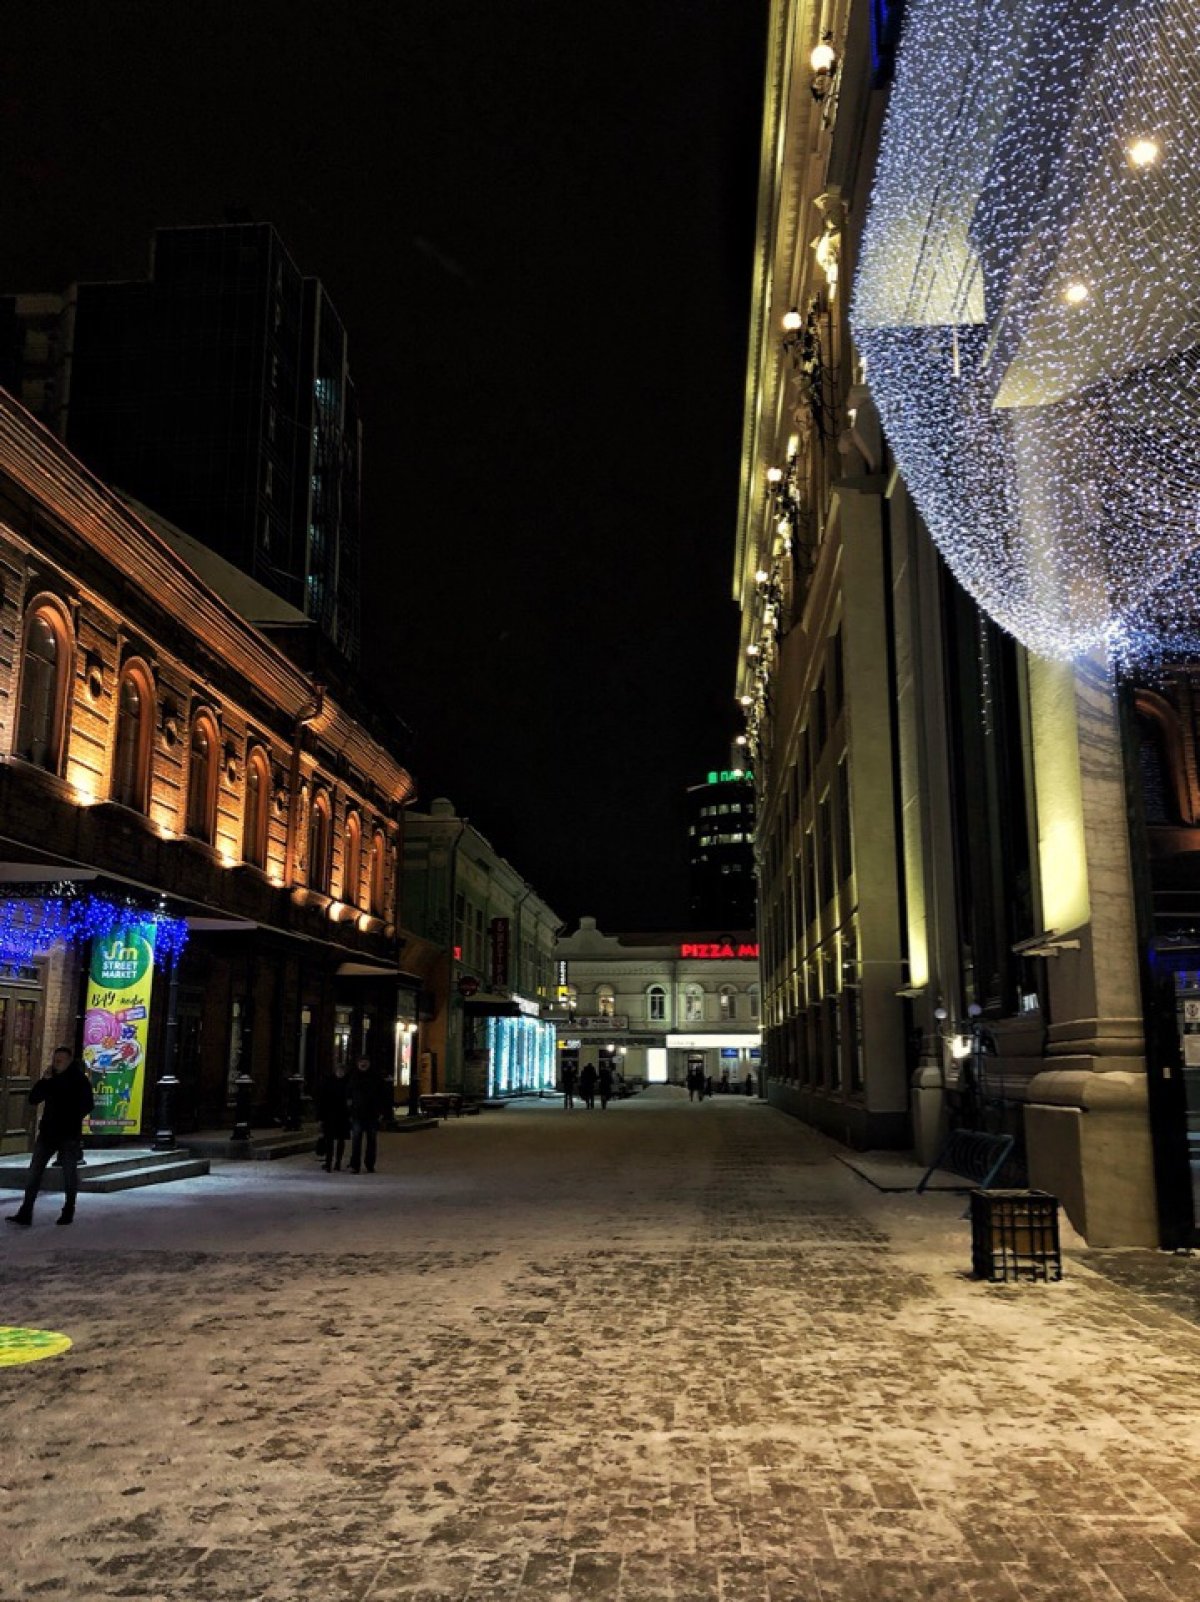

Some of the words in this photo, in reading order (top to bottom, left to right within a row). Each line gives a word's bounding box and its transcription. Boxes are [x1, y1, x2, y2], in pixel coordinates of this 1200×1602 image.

[682, 943, 735, 957] PIZZA
[103, 960, 138, 970] STREET
[101, 970, 137, 979] MARKET
